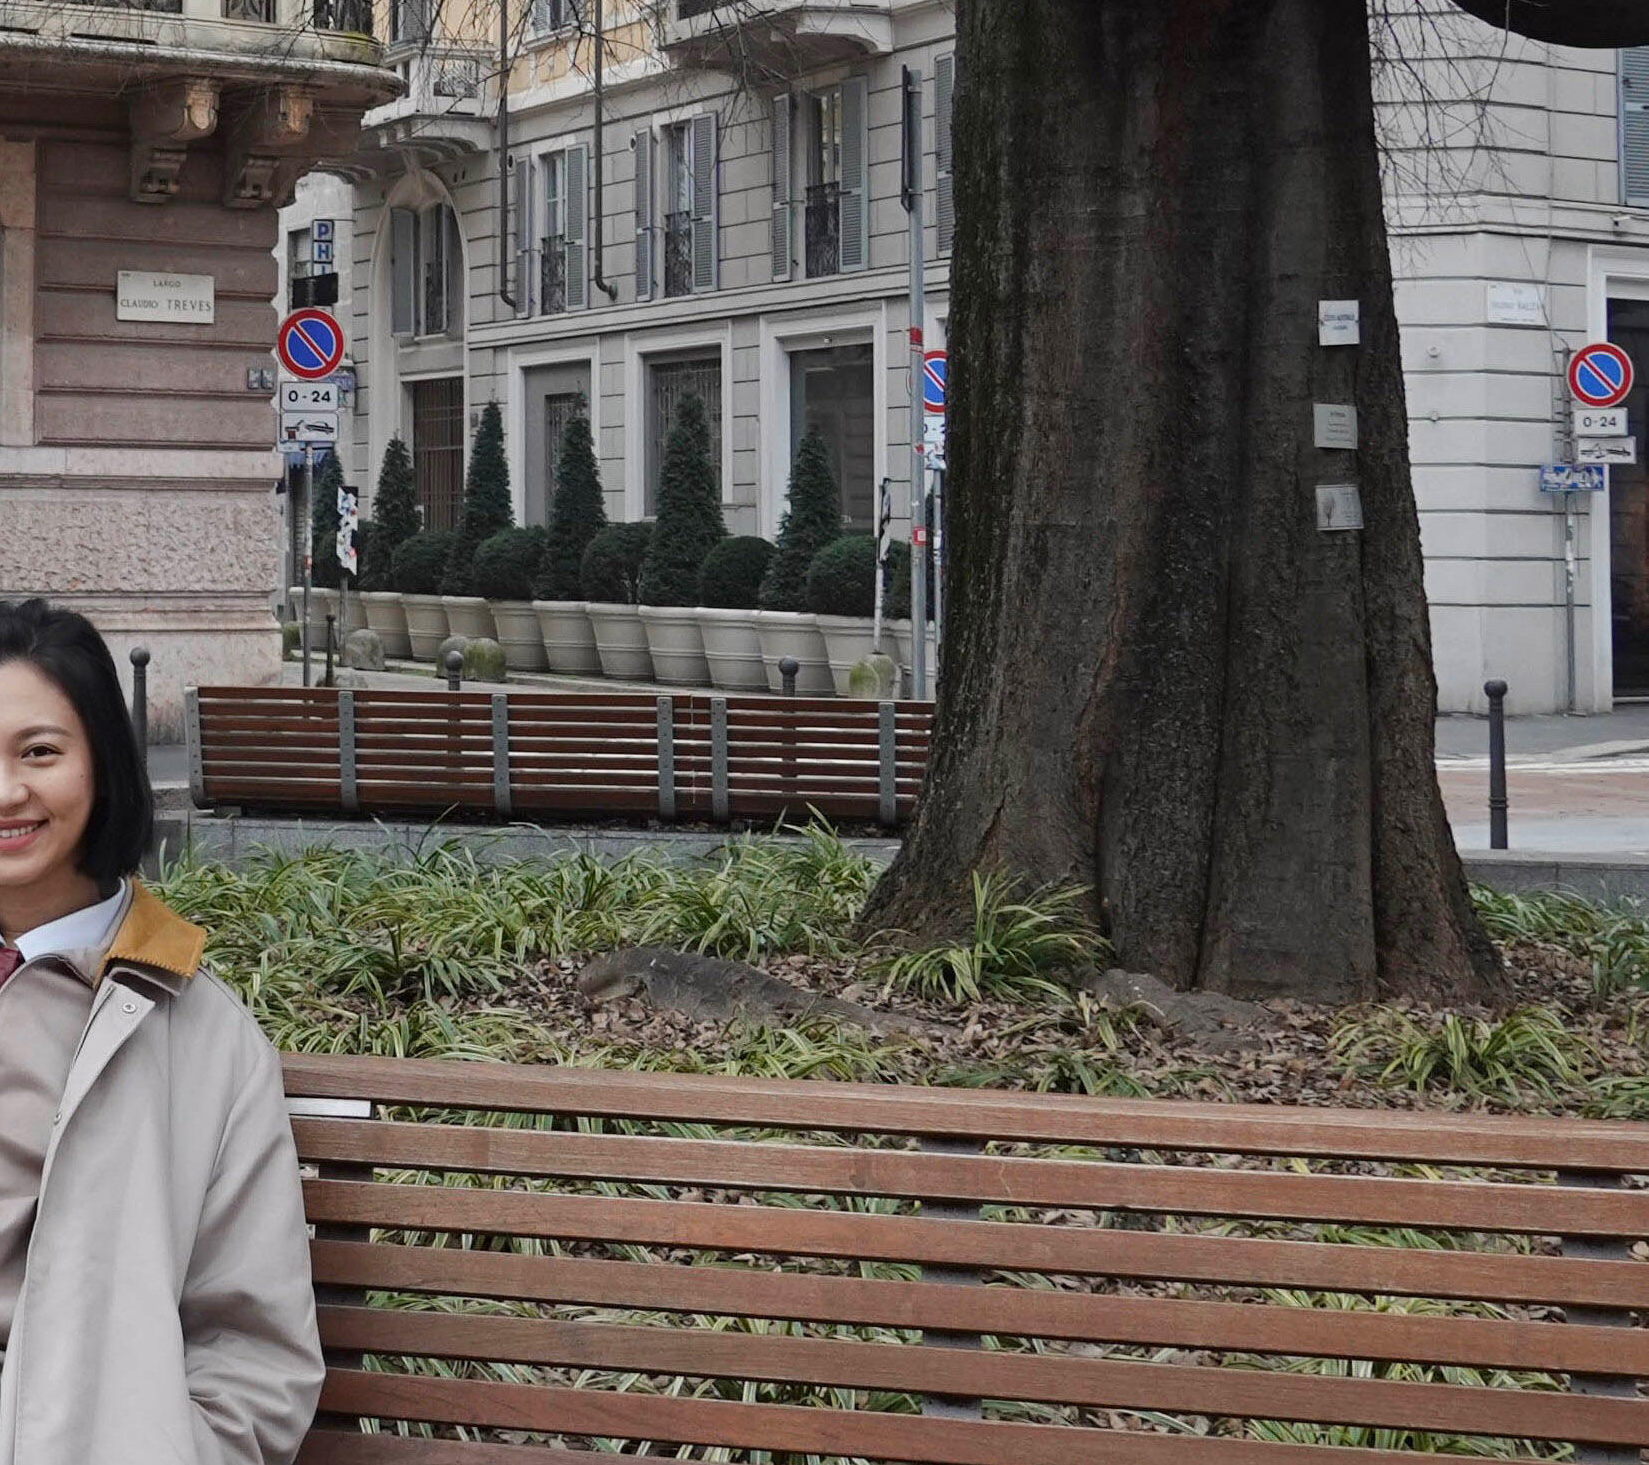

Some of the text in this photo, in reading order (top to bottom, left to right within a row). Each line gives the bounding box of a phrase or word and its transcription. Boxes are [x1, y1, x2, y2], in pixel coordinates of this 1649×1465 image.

[153, 279, 181, 288] LARGO
[120, 298, 211, 312] CLAUDIO TREVES
